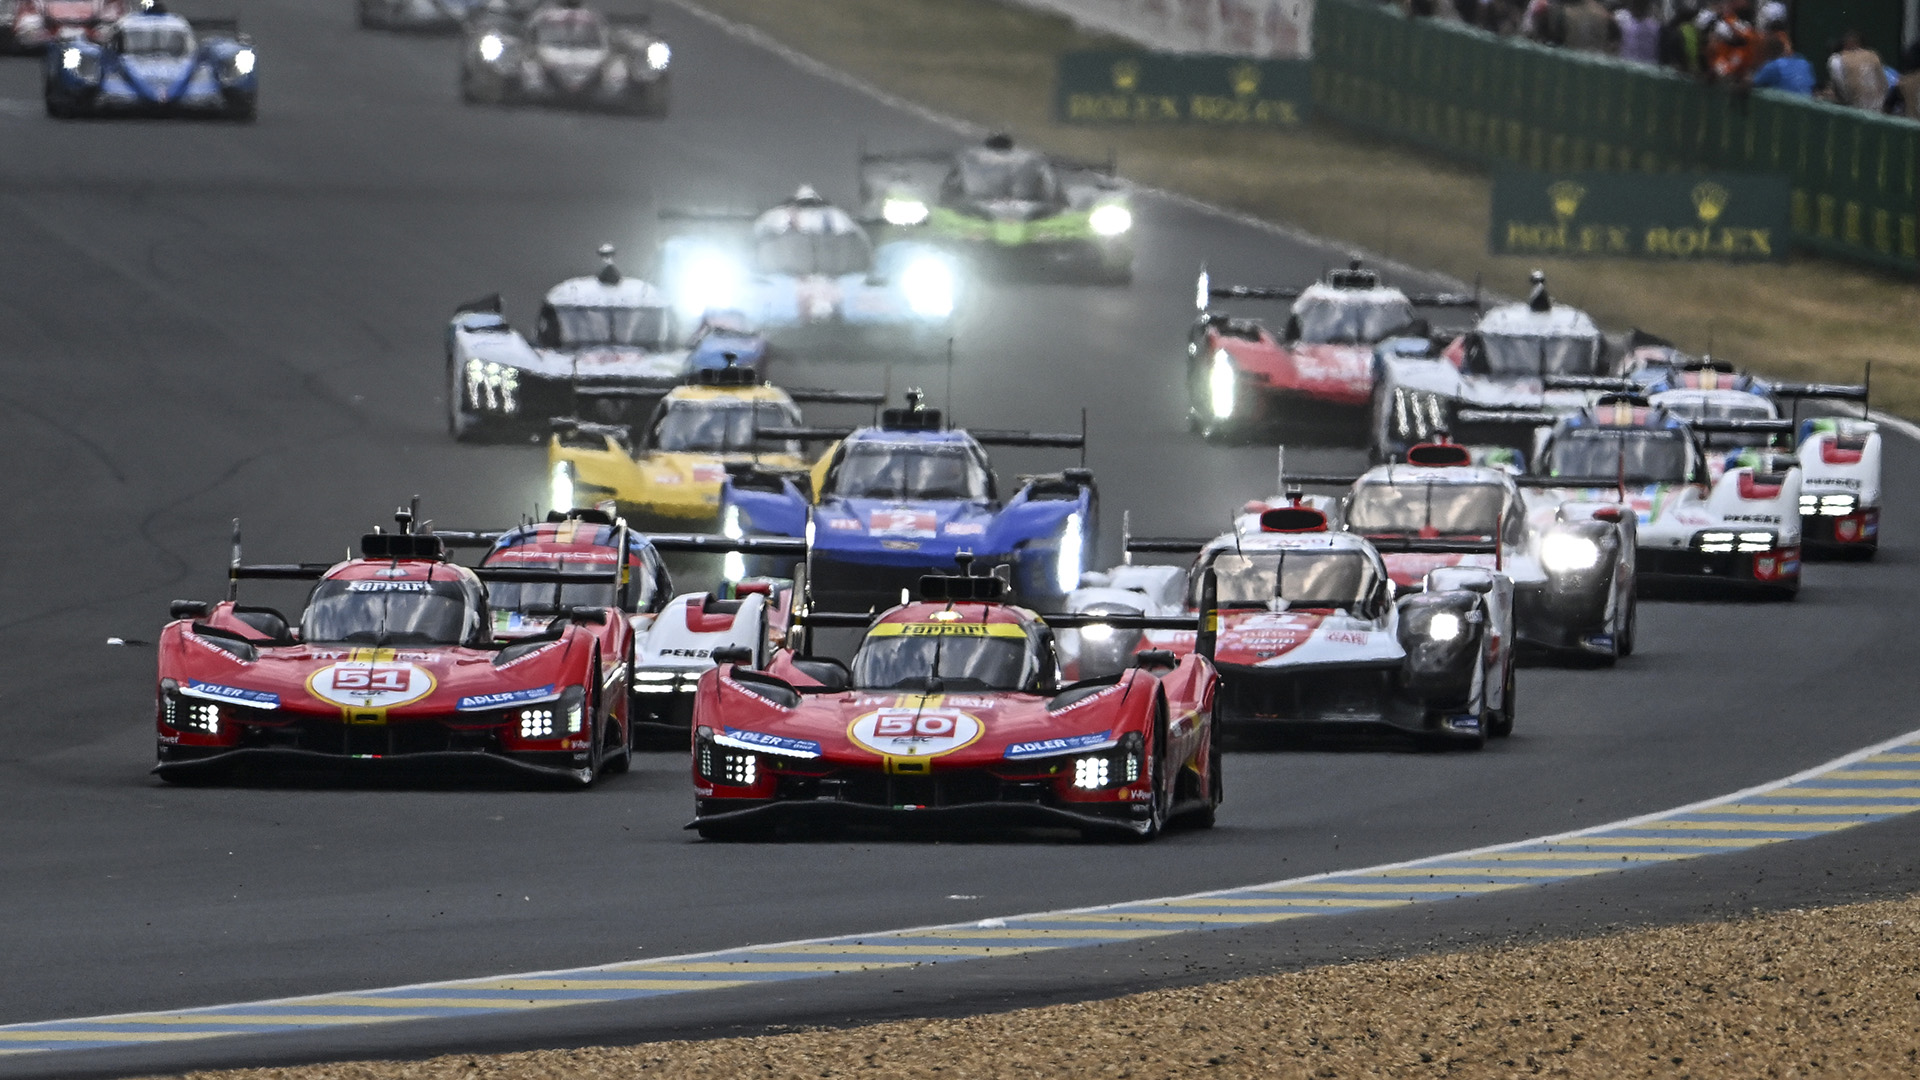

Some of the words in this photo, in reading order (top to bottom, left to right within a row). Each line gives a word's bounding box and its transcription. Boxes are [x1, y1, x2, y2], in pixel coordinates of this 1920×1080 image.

[1507, 220, 1628, 250] ROLEX
[1645, 226, 1770, 255] ROLEX
[345, 581, 434, 592] Ferrari
[901, 623, 990, 636] Ferrari
[660, 648, 714, 658] PENS
[335, 670, 407, 689] 51
[191, 684, 243, 697] ADLER
[462, 692, 514, 706] ADLER
[878, 716, 955, 735] 50
[728, 730, 782, 746] ADLER
[1011, 739, 1067, 753] ADLER
